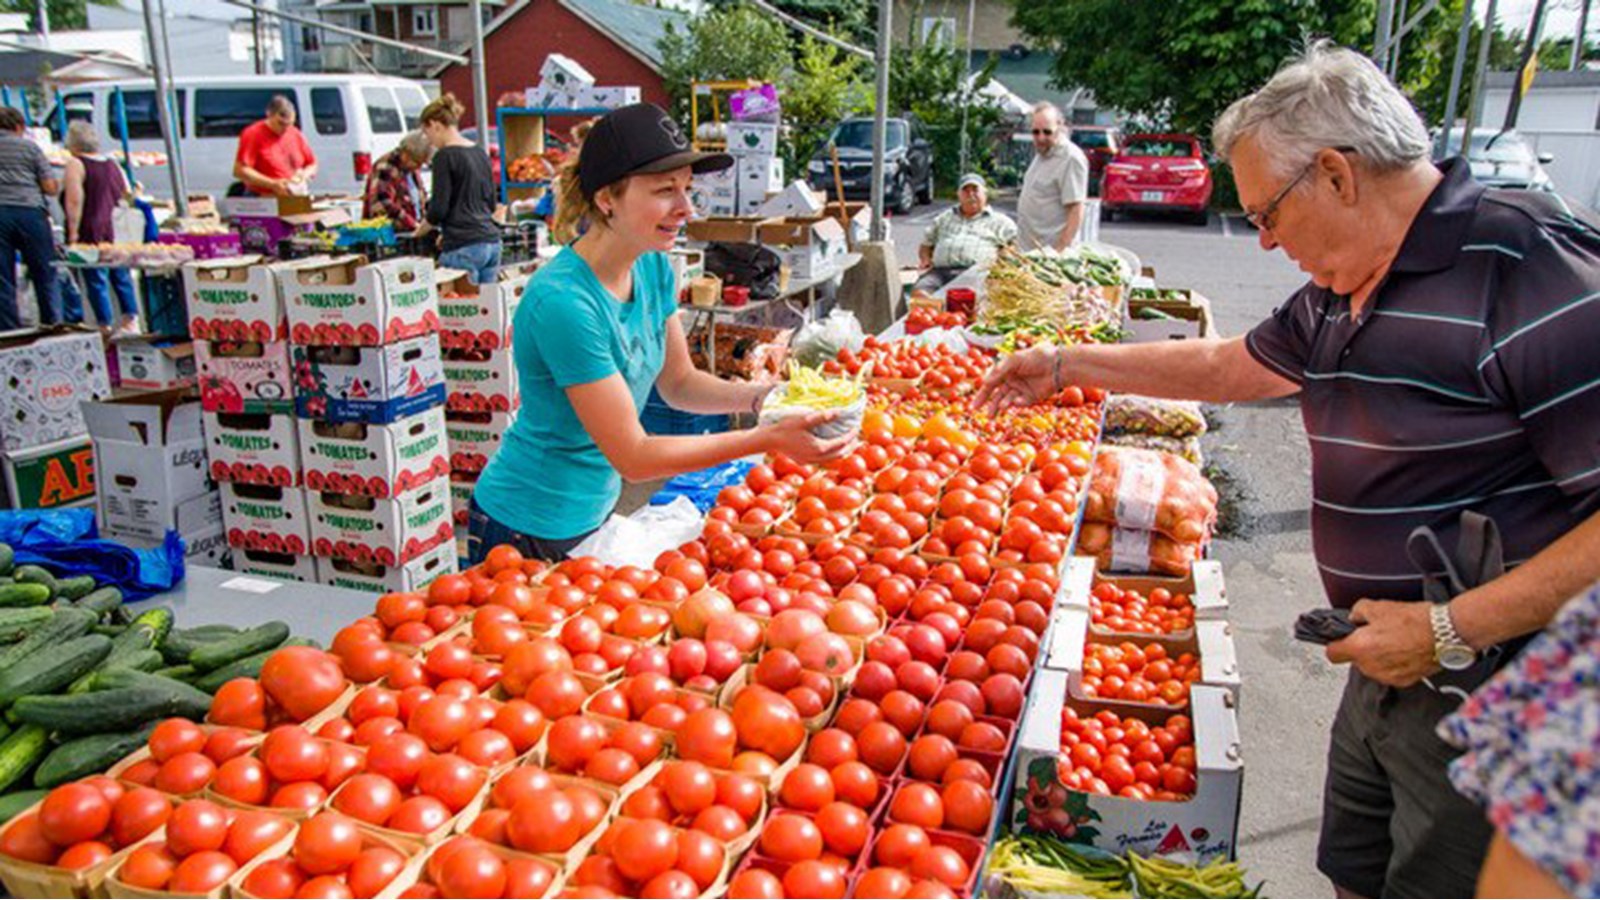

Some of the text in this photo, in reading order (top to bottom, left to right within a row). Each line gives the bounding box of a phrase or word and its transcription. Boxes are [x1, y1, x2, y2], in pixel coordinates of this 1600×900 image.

[439, 304, 478, 318] MATOES
[221, 434, 271, 450] TOMATES
[317, 442, 368, 460] TOMATES
[237, 502, 283, 519] TOMATES
